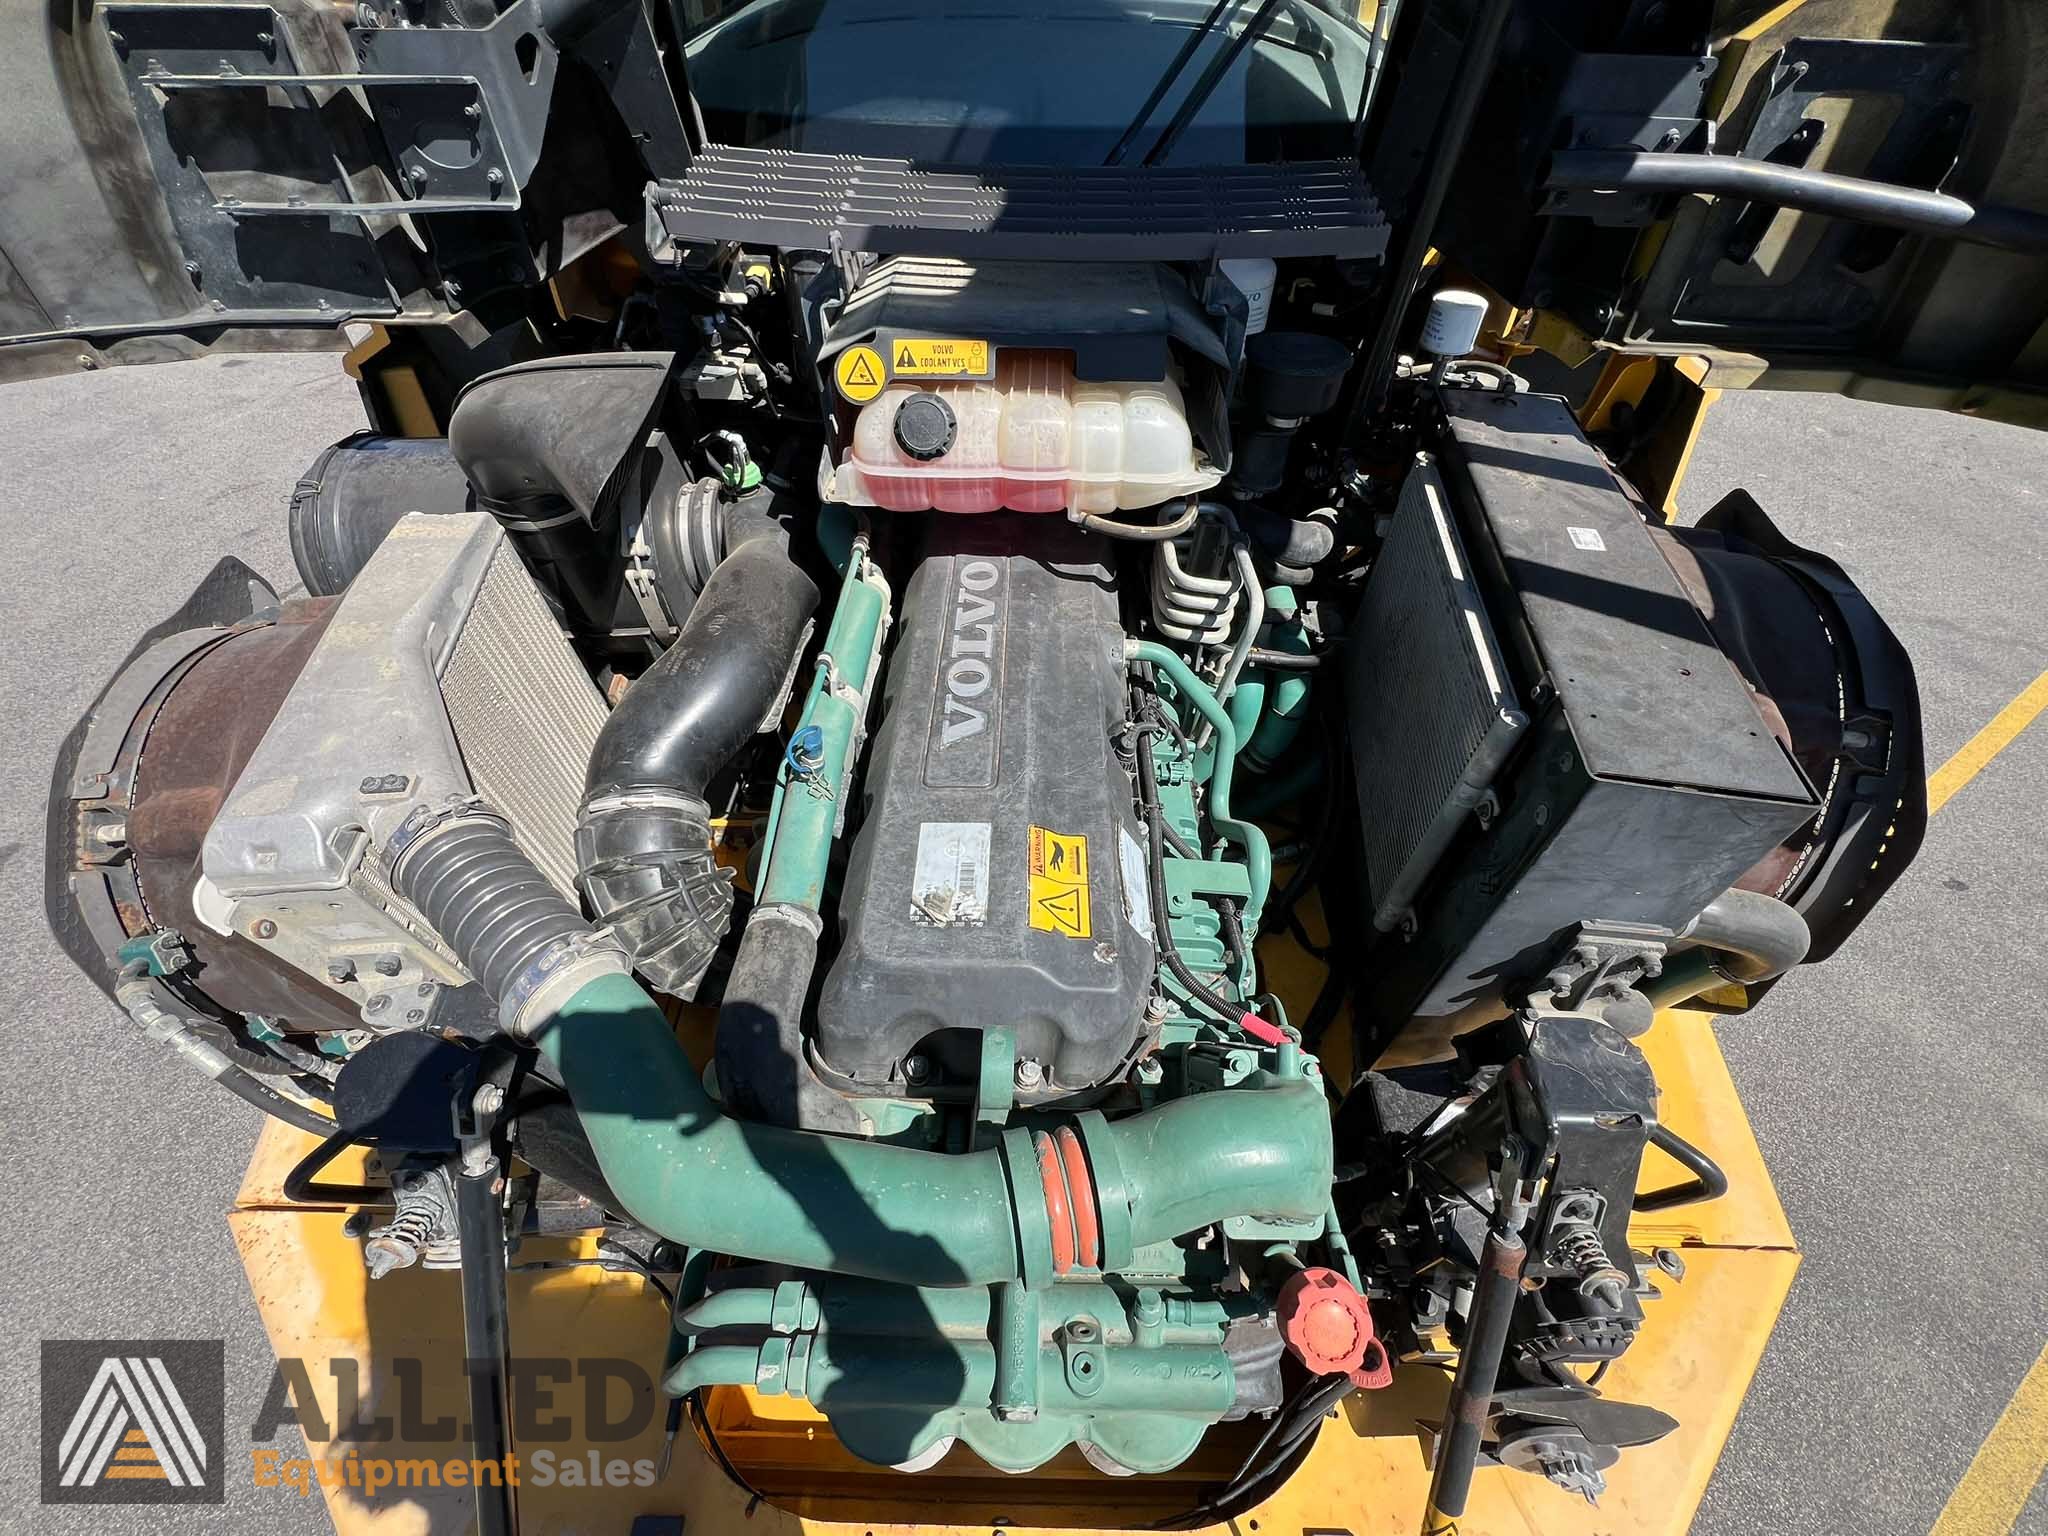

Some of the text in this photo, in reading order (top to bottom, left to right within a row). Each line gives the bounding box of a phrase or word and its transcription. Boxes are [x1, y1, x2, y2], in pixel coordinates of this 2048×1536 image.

[932, 345, 953, 354] VOLVO
[920, 357, 950, 368] COOLANT
[940, 561, 999, 749] VOLVO
